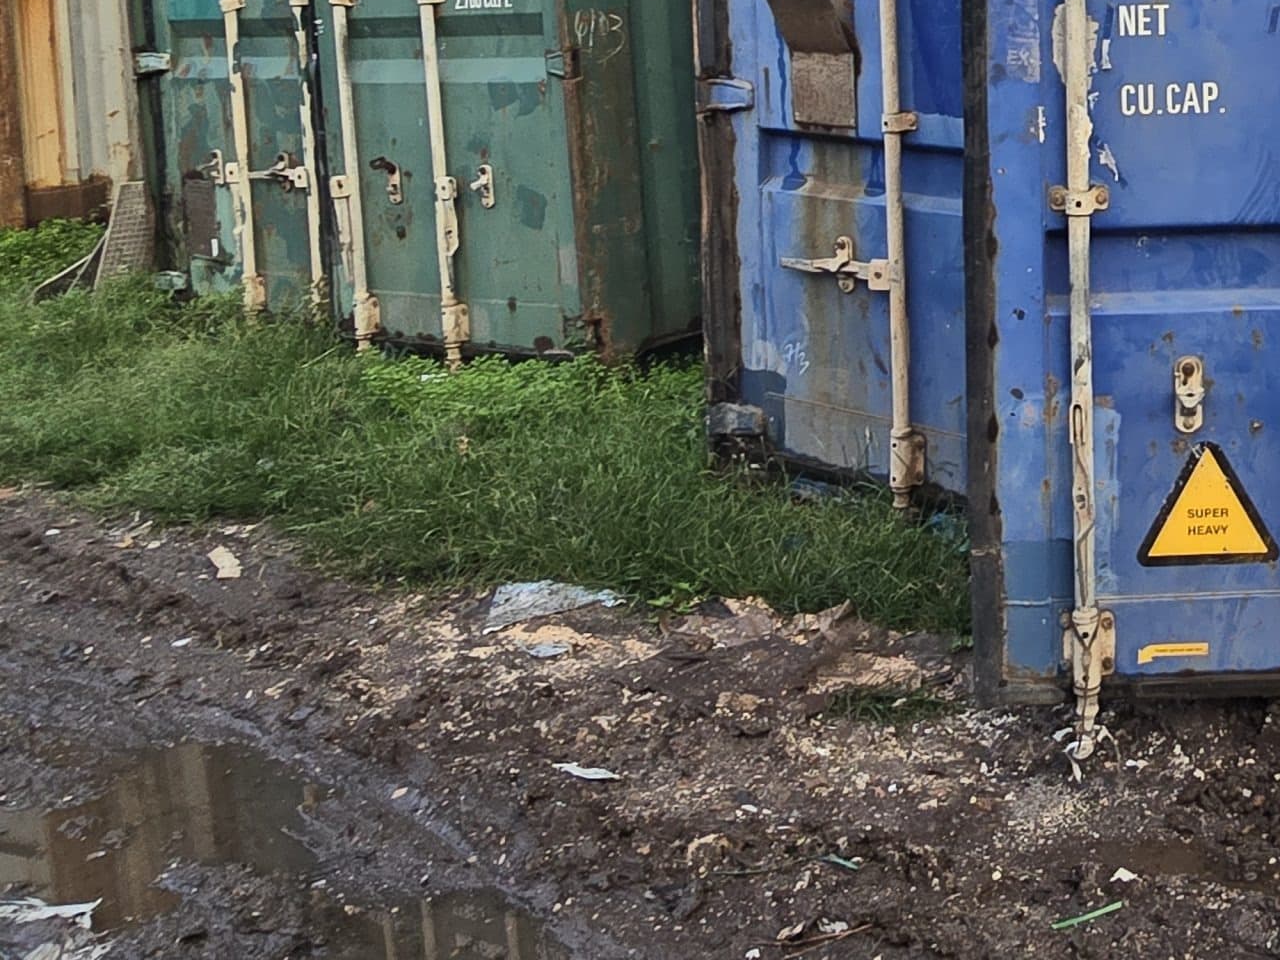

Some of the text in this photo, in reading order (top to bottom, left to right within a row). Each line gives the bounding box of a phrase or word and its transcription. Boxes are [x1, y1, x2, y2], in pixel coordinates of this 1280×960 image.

[1118, 3, 1170, 37] NET
[1120, 80, 1227, 116] CU.CAP.
[1186, 507, 1229, 519] SUPER
[1187, 524, 1229, 536] HEAVY
